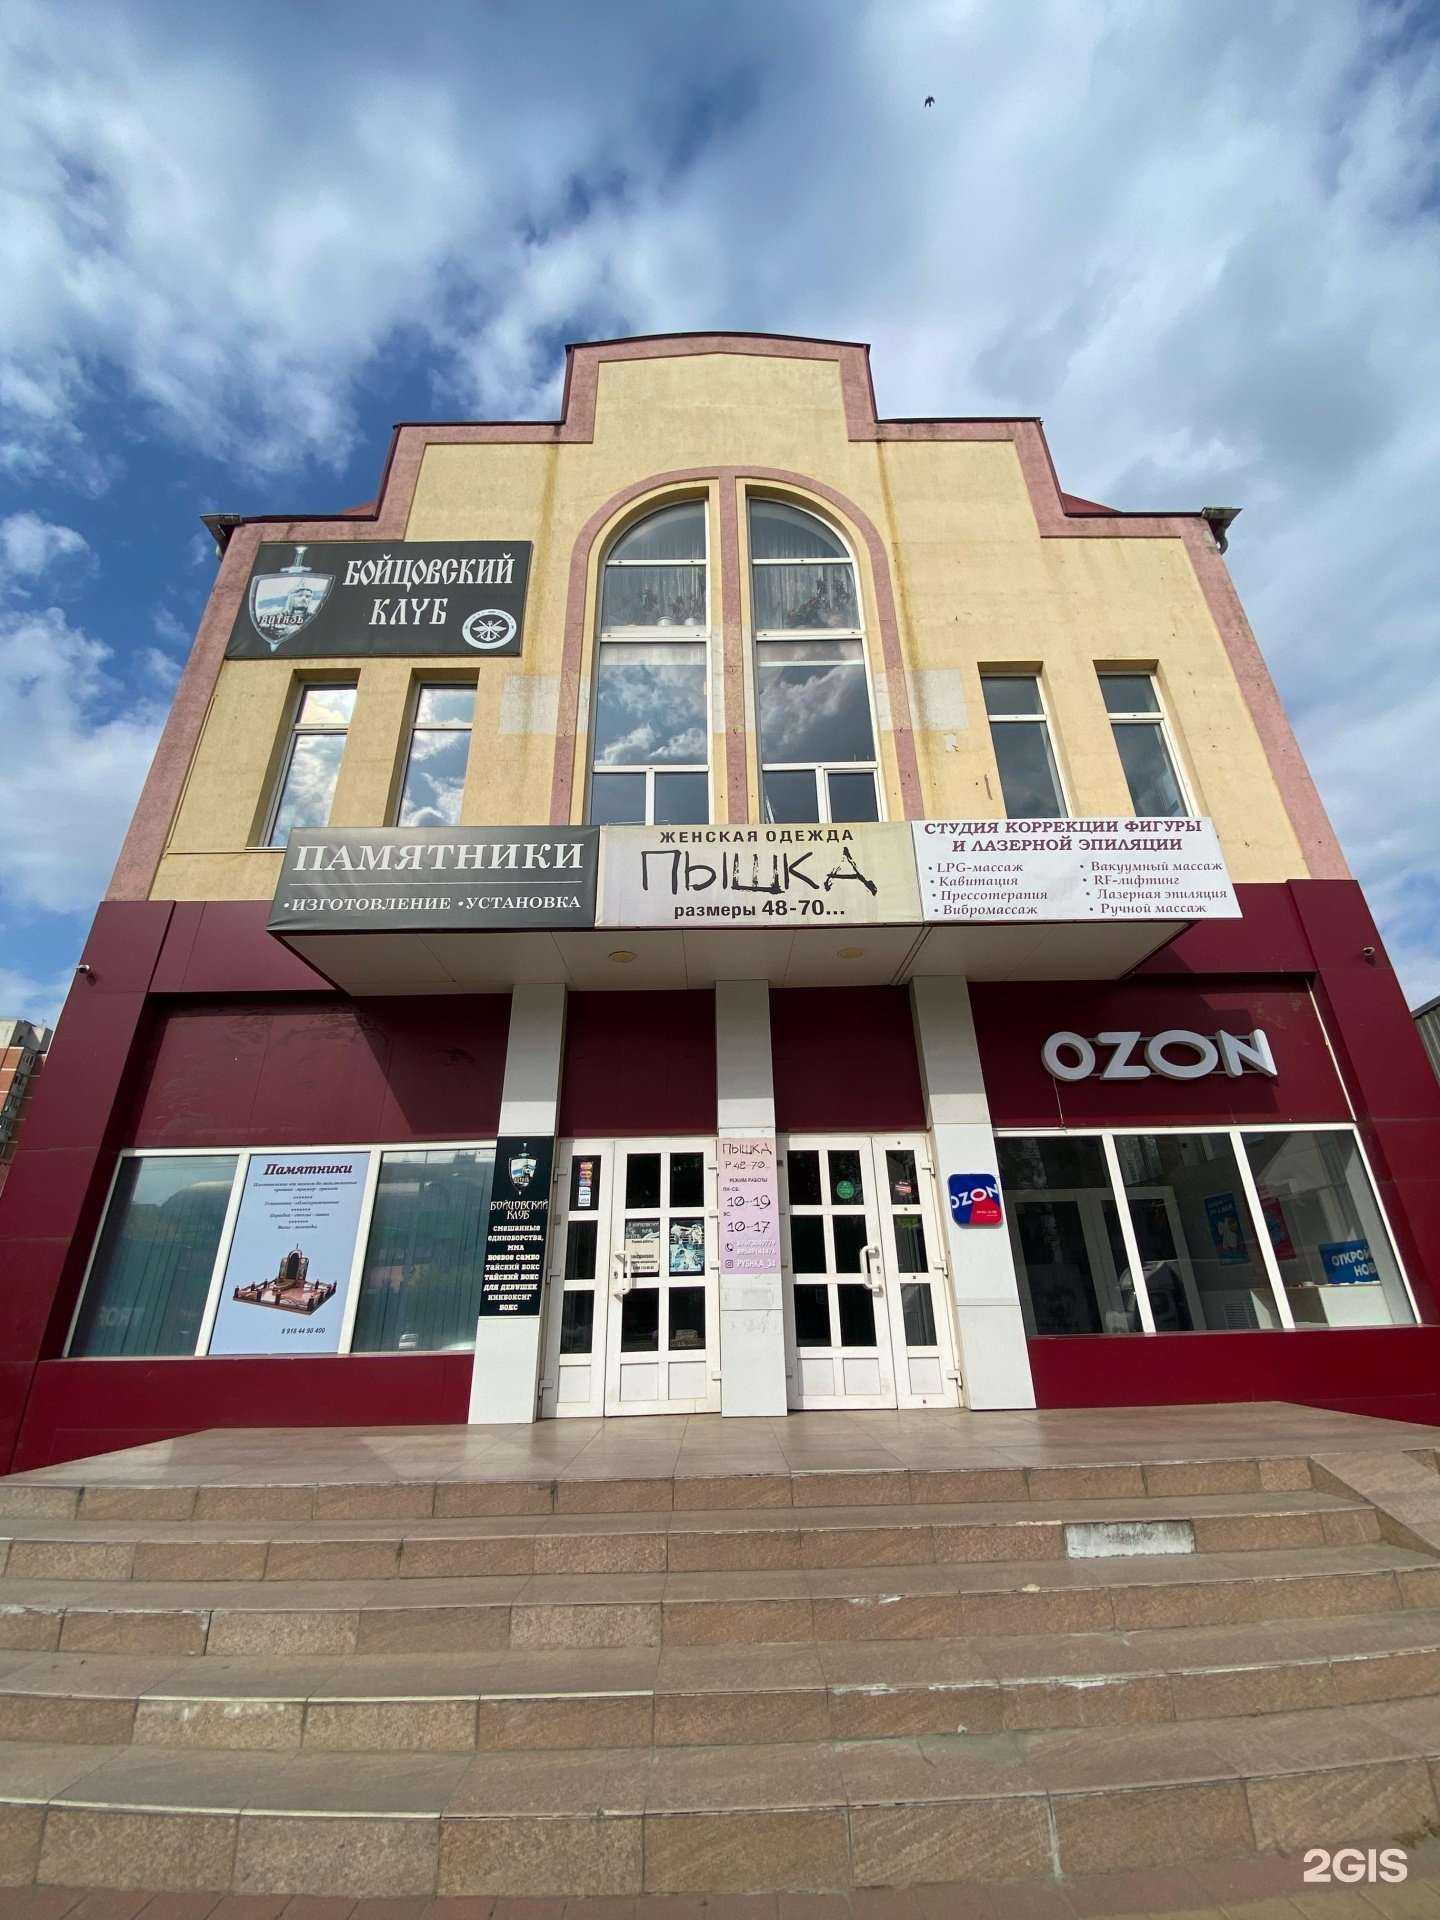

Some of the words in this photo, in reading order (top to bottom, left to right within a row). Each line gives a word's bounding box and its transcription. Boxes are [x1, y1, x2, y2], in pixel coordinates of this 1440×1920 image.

[342, 553, 516, 592] БОЙЦОВСКИЙ
[368, 598, 449, 625] КЛУБ
[924, 822, 999, 836] СТУДИЯ
[1005, 820, 1118, 834] КОРРЕКЦИИ
[1124, 820, 1202, 833] ФИГУРЫ
[659, 830, 758, 844] ЖЕНСКАЯ
[766, 829, 854, 843] ОДЕЖДА
[952, 840, 966, 852] И
[971, 836, 1072, 852] ЛАЗЕРНОЙ
[1079, 838, 1182, 852] ЭПИЛЯЦИИ
[293, 843, 585, 871] ПАМЯТНИКИ
[640, 847, 878, 896] ПЫШКА
[937, 863, 1024, 873] LPG-массаж
[1091, 861, 1169, 874] Вакуумный
[1173, 863, 1224, 872] массаж
[939, 876, 1018, 888] Кавитация
[1094, 875, 1180, 888] RF-лифтинг
[941, 890, 1048, 903] Прессотерапия
[1097, 889, 1161, 902] Лазерная
[1164, 891, 1228, 901] эпиляция
[292, 897, 451, 911] ИЗГОТОВЛЕНИЕ
[466, 896, 582, 910] УСТАНОВКА
[674, 903, 756, 919] размеры
[943, 904, 1038, 917] Вибромассаж
[1101, 903, 1151, 917] Ручной
[1155, 905, 1207, 914] массаж
[1041, 1029, 1278, 1081] OZON
[722, 1143, 772, 1155] ПЫШКА
[264, 1163, 353, 1176] Памятники
[951, 1183, 999, 1209] OZON
